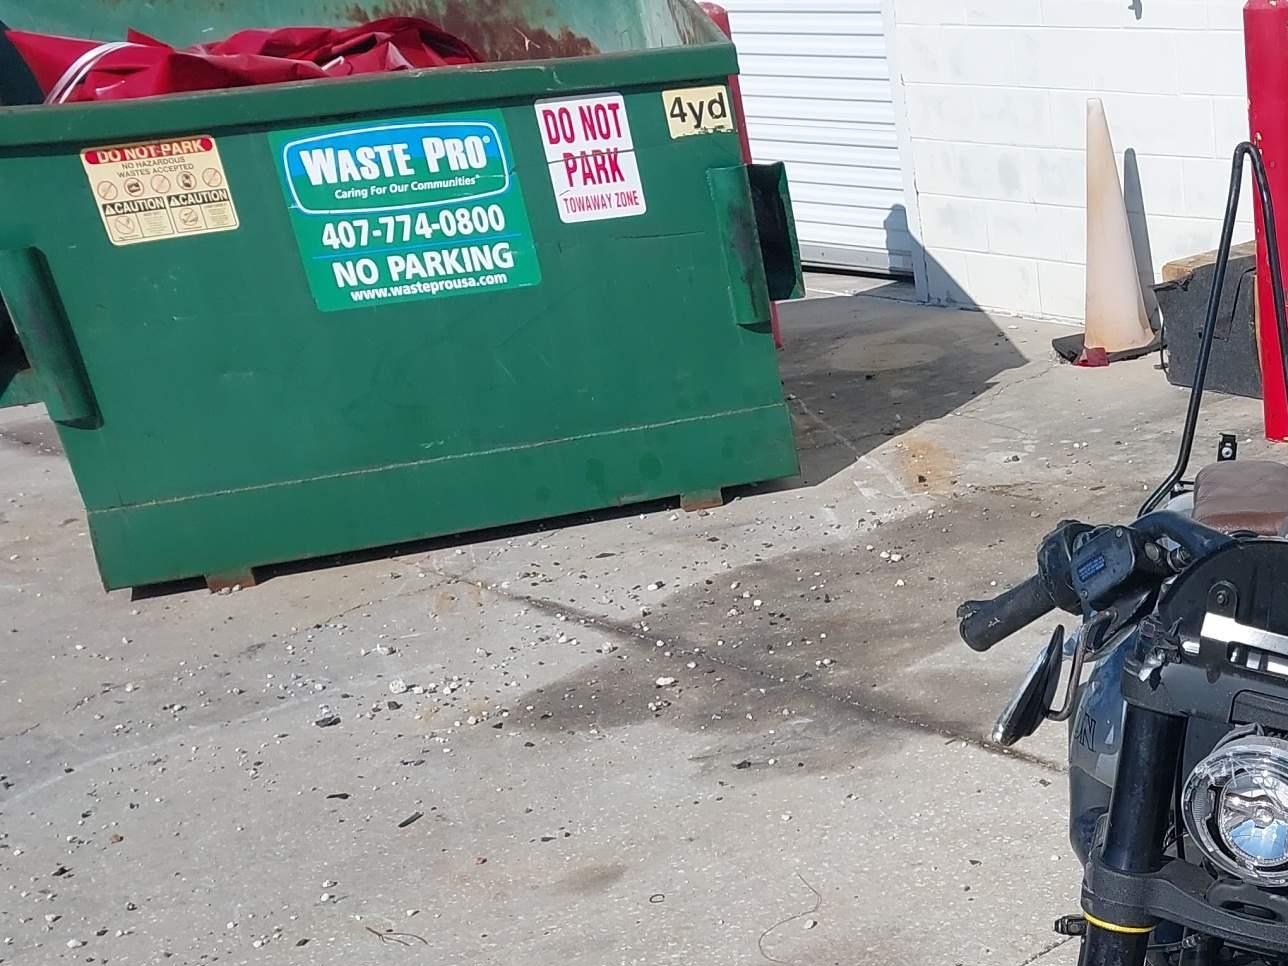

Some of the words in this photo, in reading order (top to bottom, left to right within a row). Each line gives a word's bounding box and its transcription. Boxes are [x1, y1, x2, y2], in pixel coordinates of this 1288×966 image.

[669, 92, 727, 128] 4yd
[542, 107, 575, 144] DO
[578, 103, 623, 141] NOT
[96, 149, 121, 164] DO
[124, 145, 156, 161] NOT
[160, 139, 205, 156] PARK
[122, 161, 134, 170] NO
[136, 156, 186, 168] HAZARDOUS
[299, 143, 415, 186] WASTE
[117, 168, 150, 178] WASTES
[153, 163, 194, 174] ACCEPTED
[562, 147, 625, 188] PARK
[179, 189, 228, 206] CAUTION
[334, 187, 368, 200] Caring
[370, 184, 387, 195] For
[389, 183, 409, 194] Our
[410, 177, 476, 191] Communities
[114, 198, 164, 214] CAUTION
[563, 194, 614, 214] TOWAWAY
[616, 190, 640, 208] ZONE
[321, 204, 506, 249] 407-774-0800
[332, 257, 380, 288] NO
[388, 242, 515, 282] PARKING
[350, 273, 508, 301] www.wasteprousa.com
